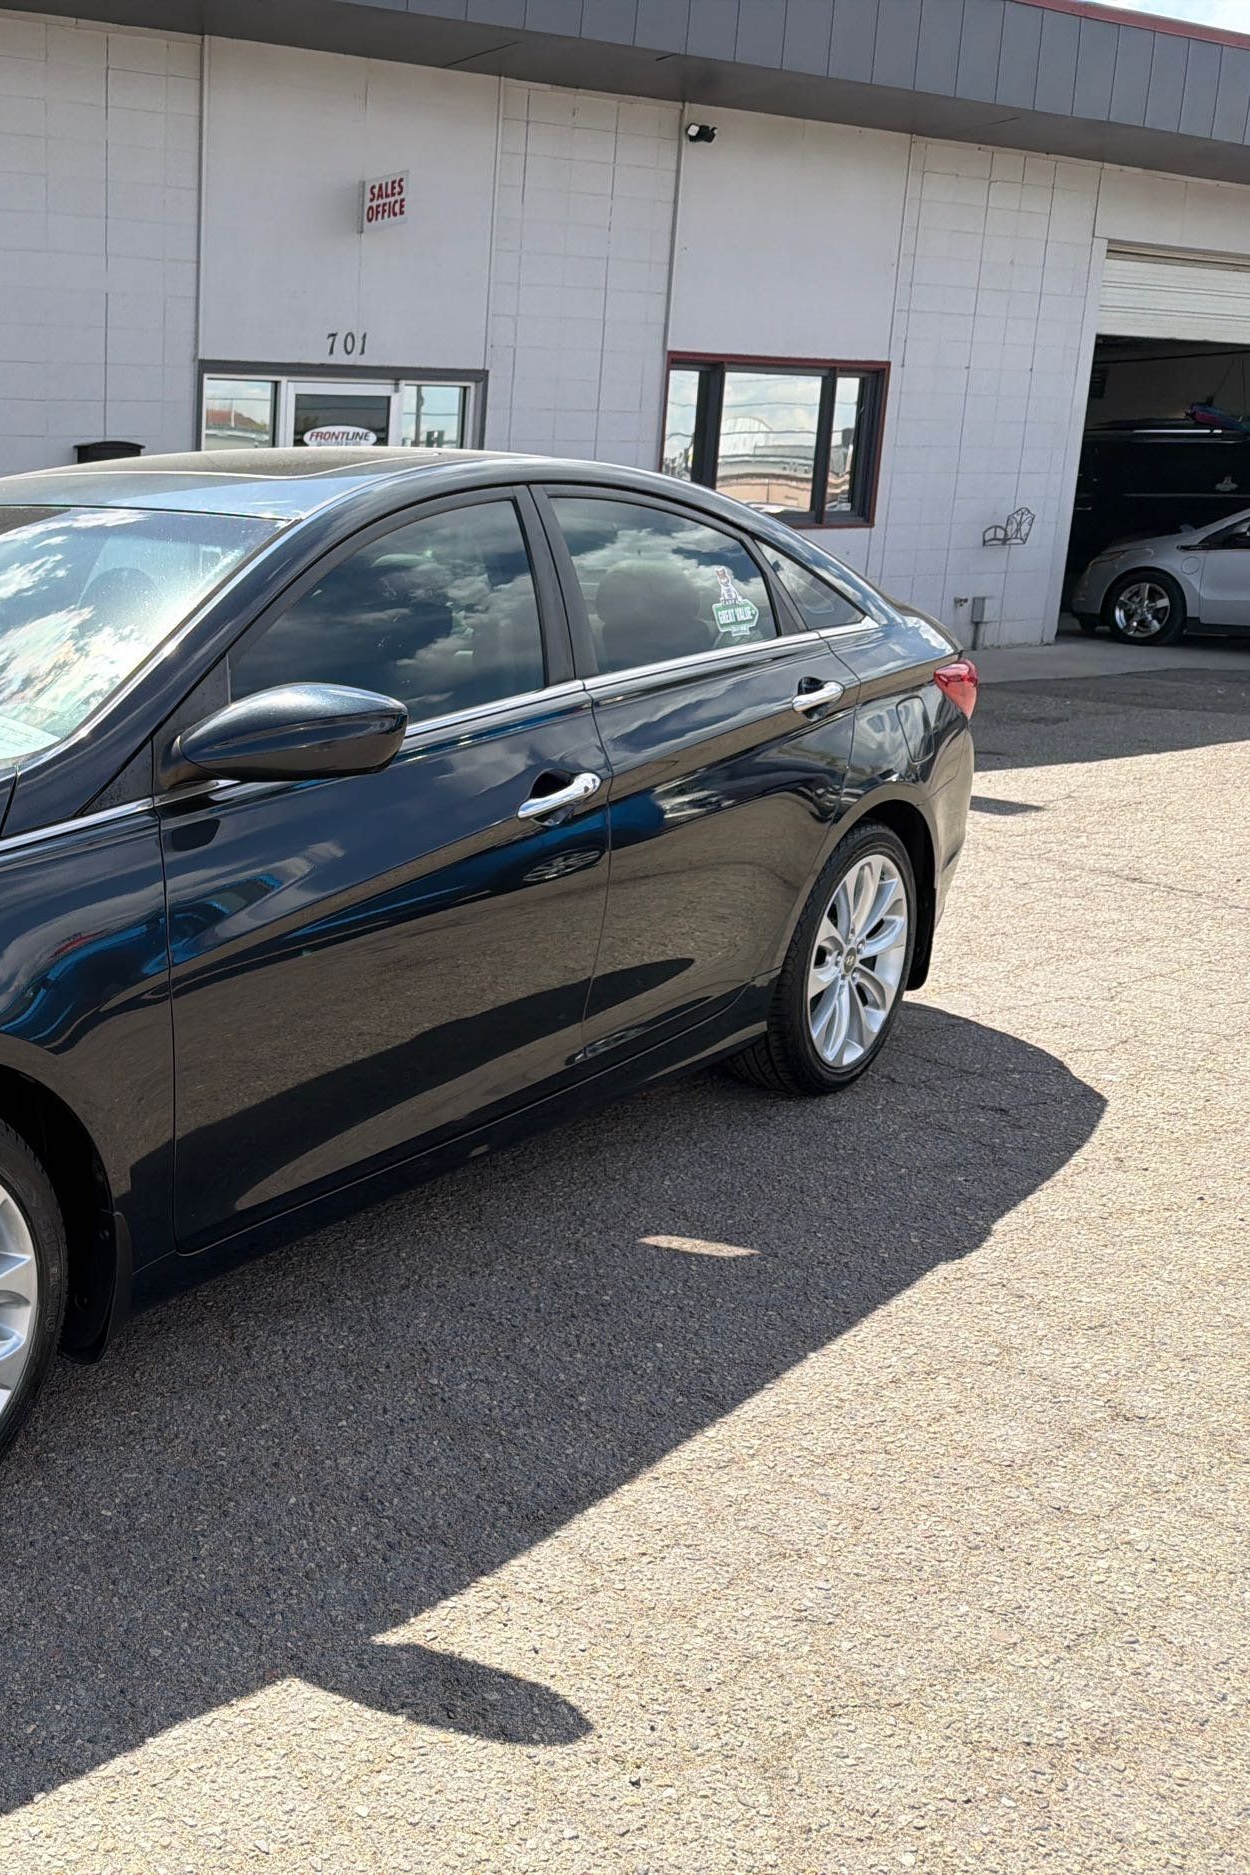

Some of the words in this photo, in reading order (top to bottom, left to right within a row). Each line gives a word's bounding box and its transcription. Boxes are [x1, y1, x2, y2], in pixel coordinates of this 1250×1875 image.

[369, 177, 405, 203] SALES
[366, 198, 406, 223] OFFICE
[326, 332, 367, 356] 701
[309, 431, 371, 442] FRONTLINE
[717, 608, 737, 624] GREAT
